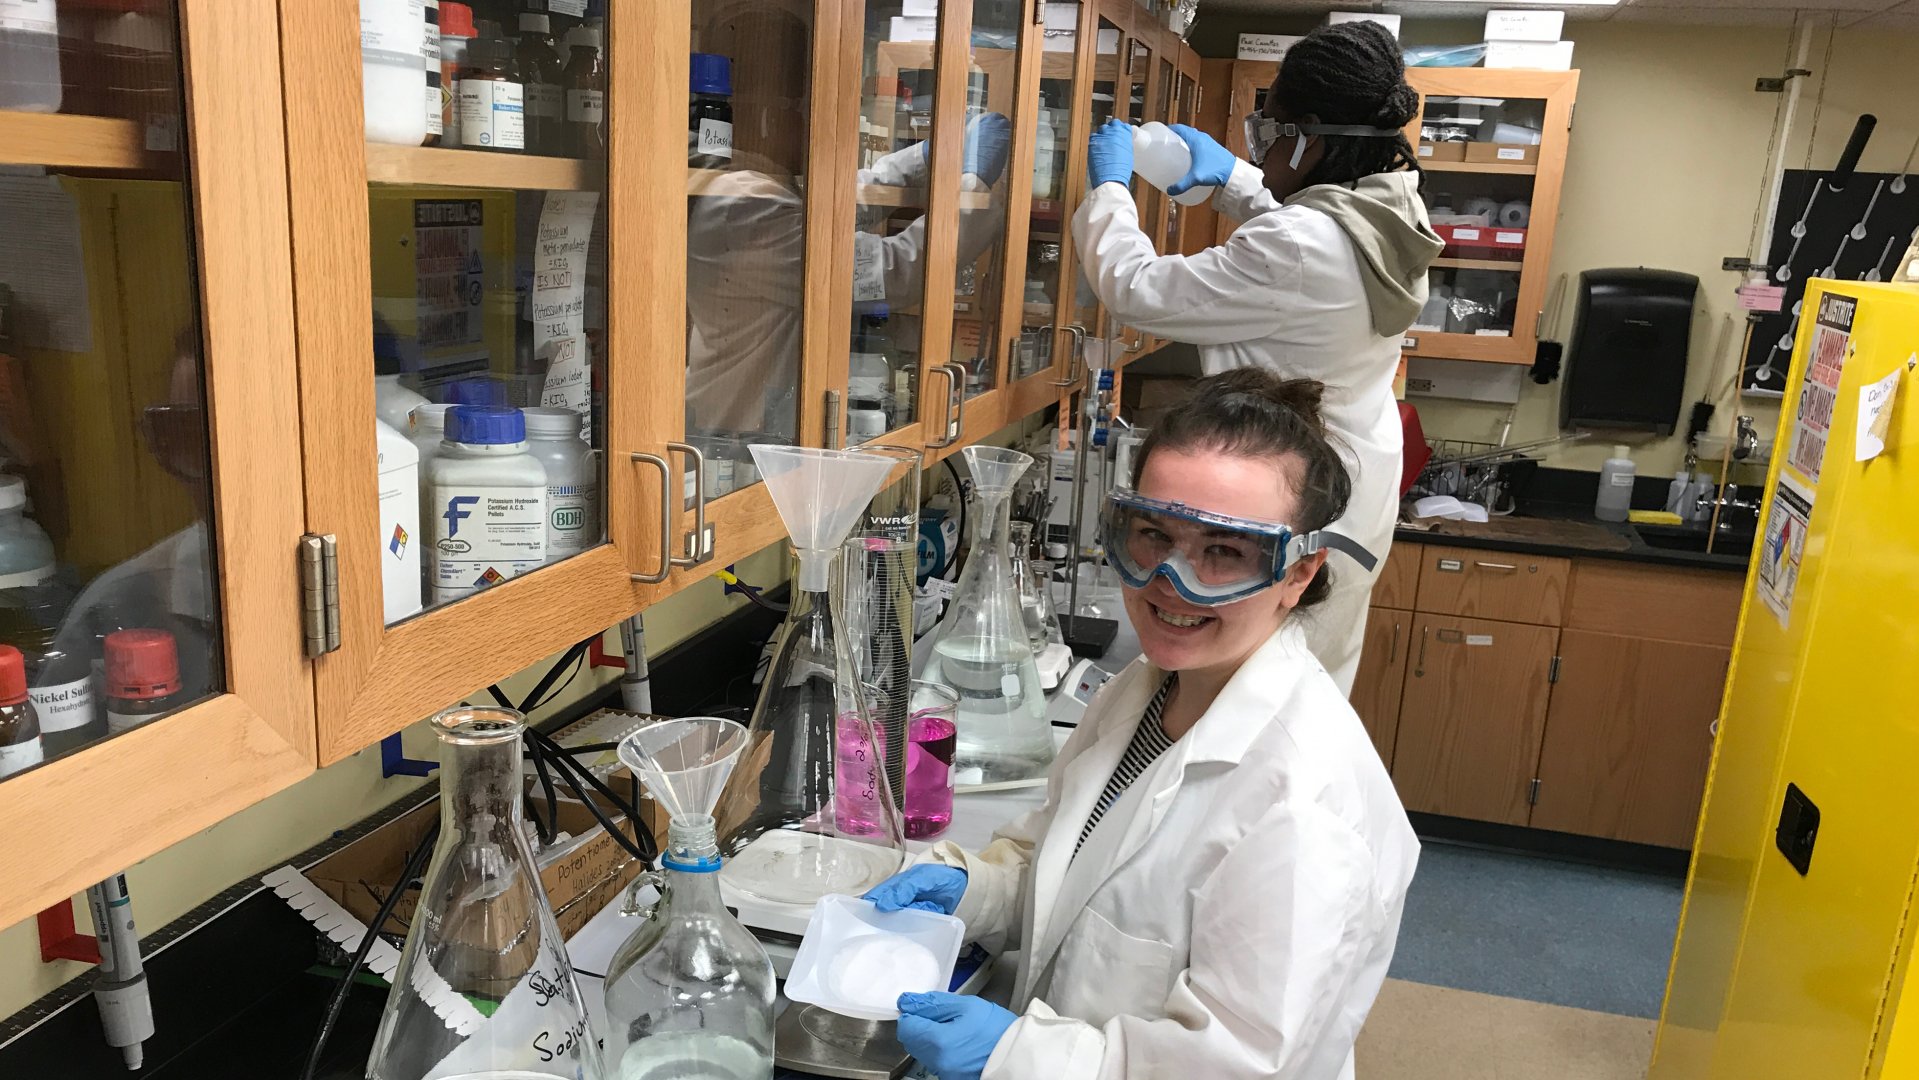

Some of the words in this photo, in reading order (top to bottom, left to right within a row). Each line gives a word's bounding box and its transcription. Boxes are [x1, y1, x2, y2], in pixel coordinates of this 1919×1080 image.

[553, 271, 571, 287] NOT
[559, 341, 576, 360] NOT
[556, 512, 582, 526] BDH
[870, 516, 901, 525] VWR
[30, 690, 68, 704] Nickel
